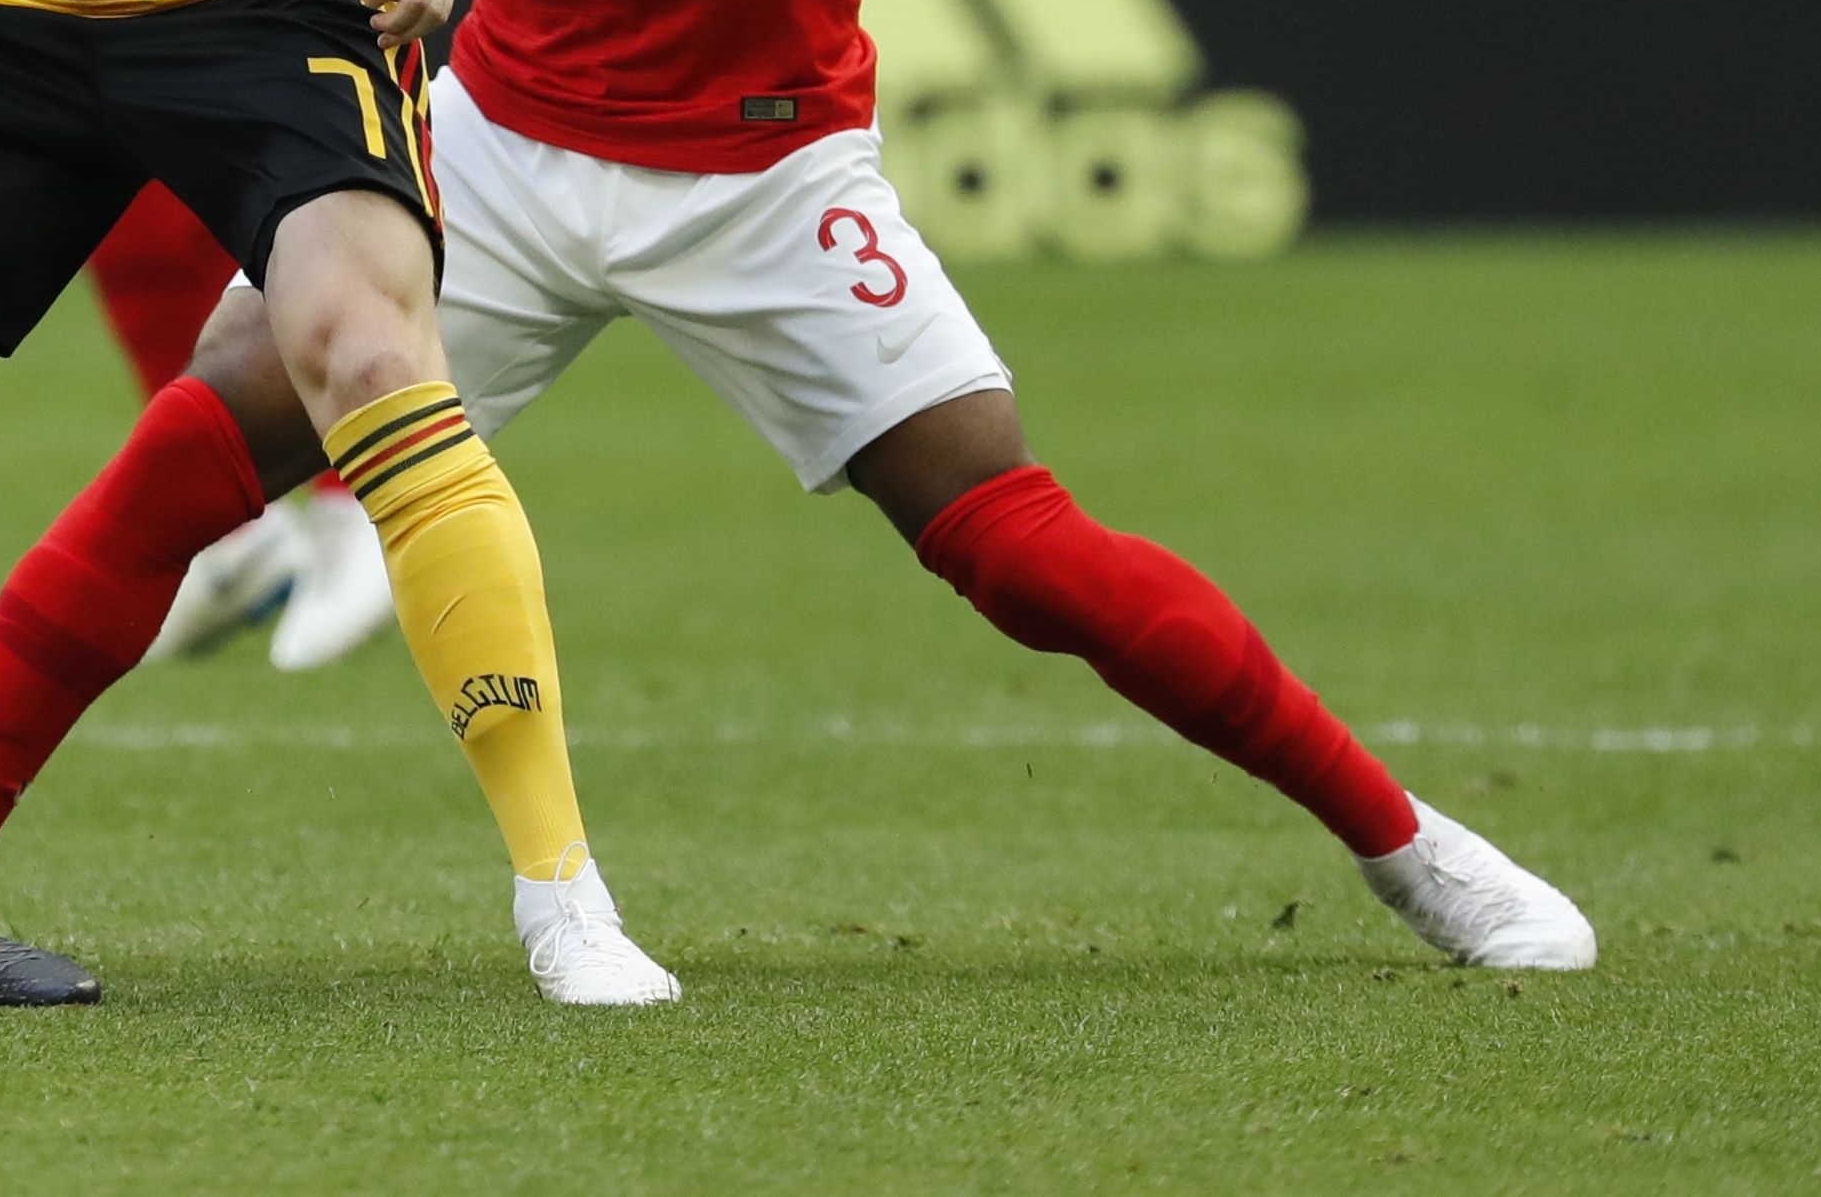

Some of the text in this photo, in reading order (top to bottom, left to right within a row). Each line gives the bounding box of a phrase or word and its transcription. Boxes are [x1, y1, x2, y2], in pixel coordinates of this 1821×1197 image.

[306, 56, 387, 160] 7
[817, 207, 908, 308] 3
[449, 674, 542, 740] BELGIUM
